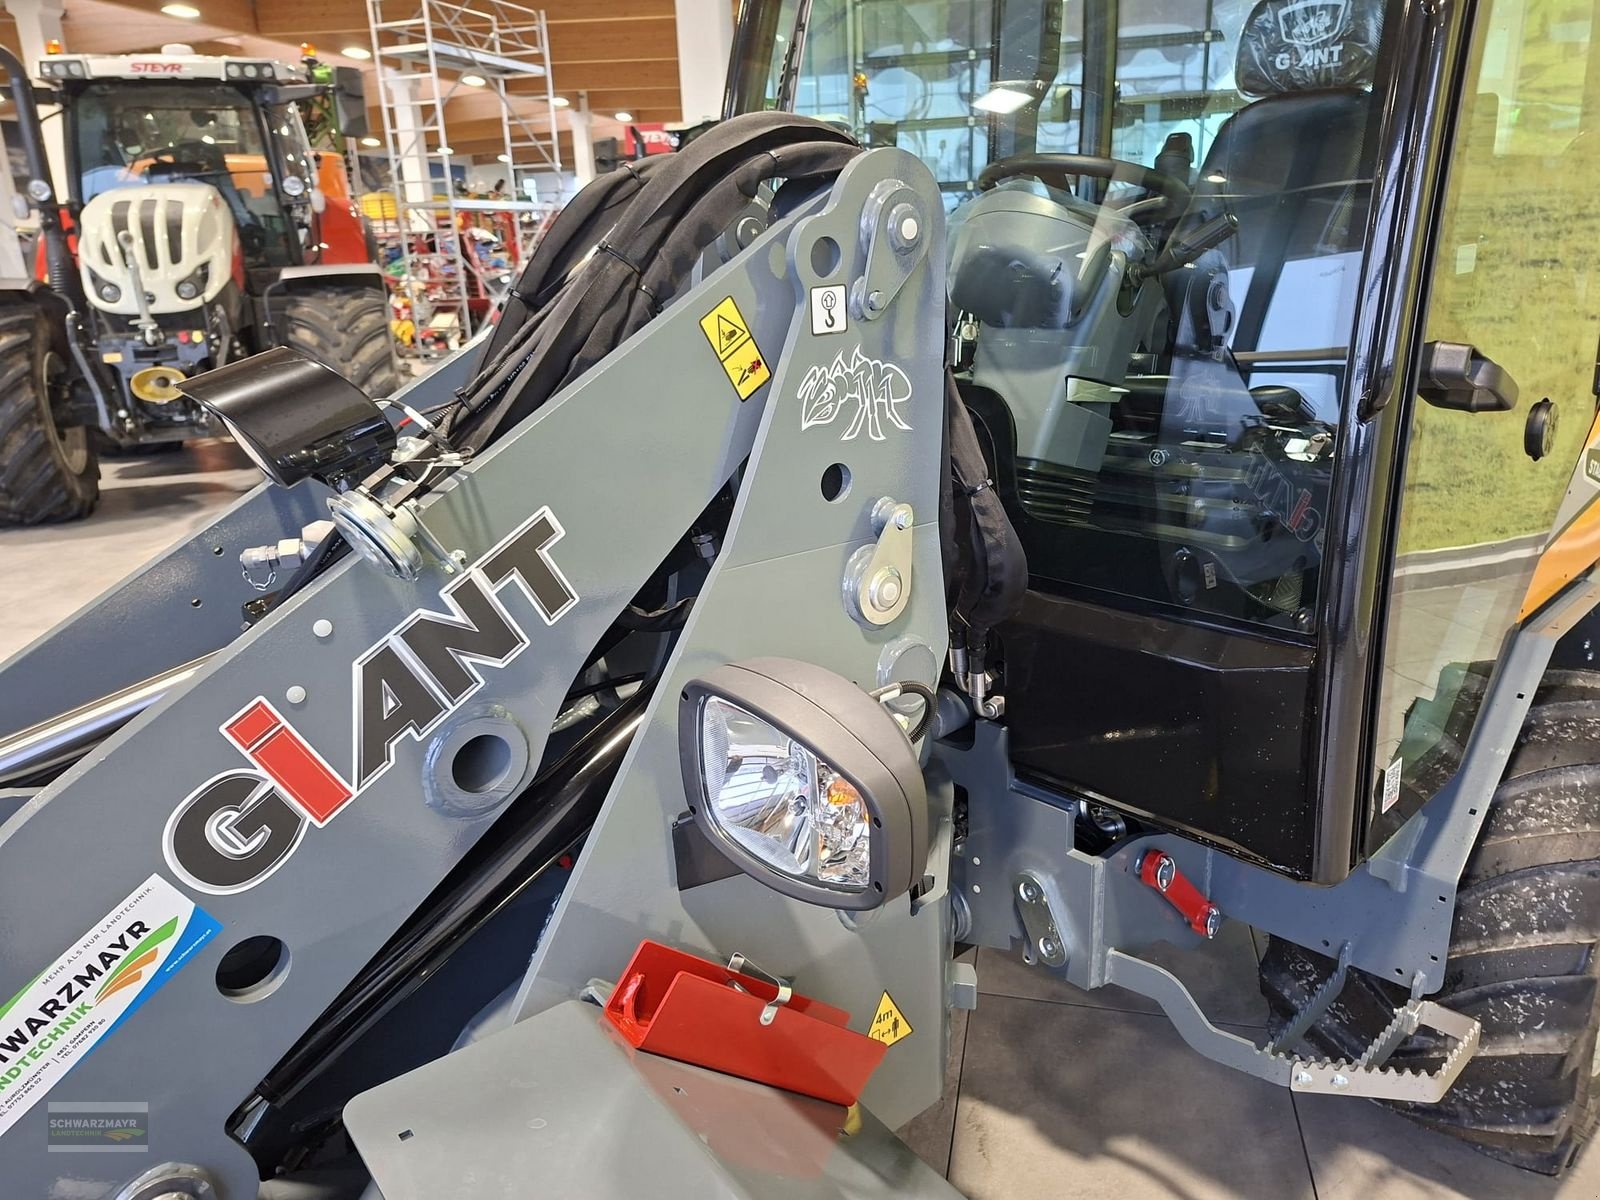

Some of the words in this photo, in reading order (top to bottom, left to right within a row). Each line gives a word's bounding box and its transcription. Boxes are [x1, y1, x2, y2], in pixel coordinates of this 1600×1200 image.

[130, 62, 183, 74] STEYR
[42, 964, 66, 986] MEHR
[67, 950, 83, 965] ALS
[83, 933, 101, 949] NUR
[100, 886, 156, 933] LANDTECHNIK.
[876, 1009, 893, 1024] 4m
[69, 1021, 95, 1044] GAMPERN
